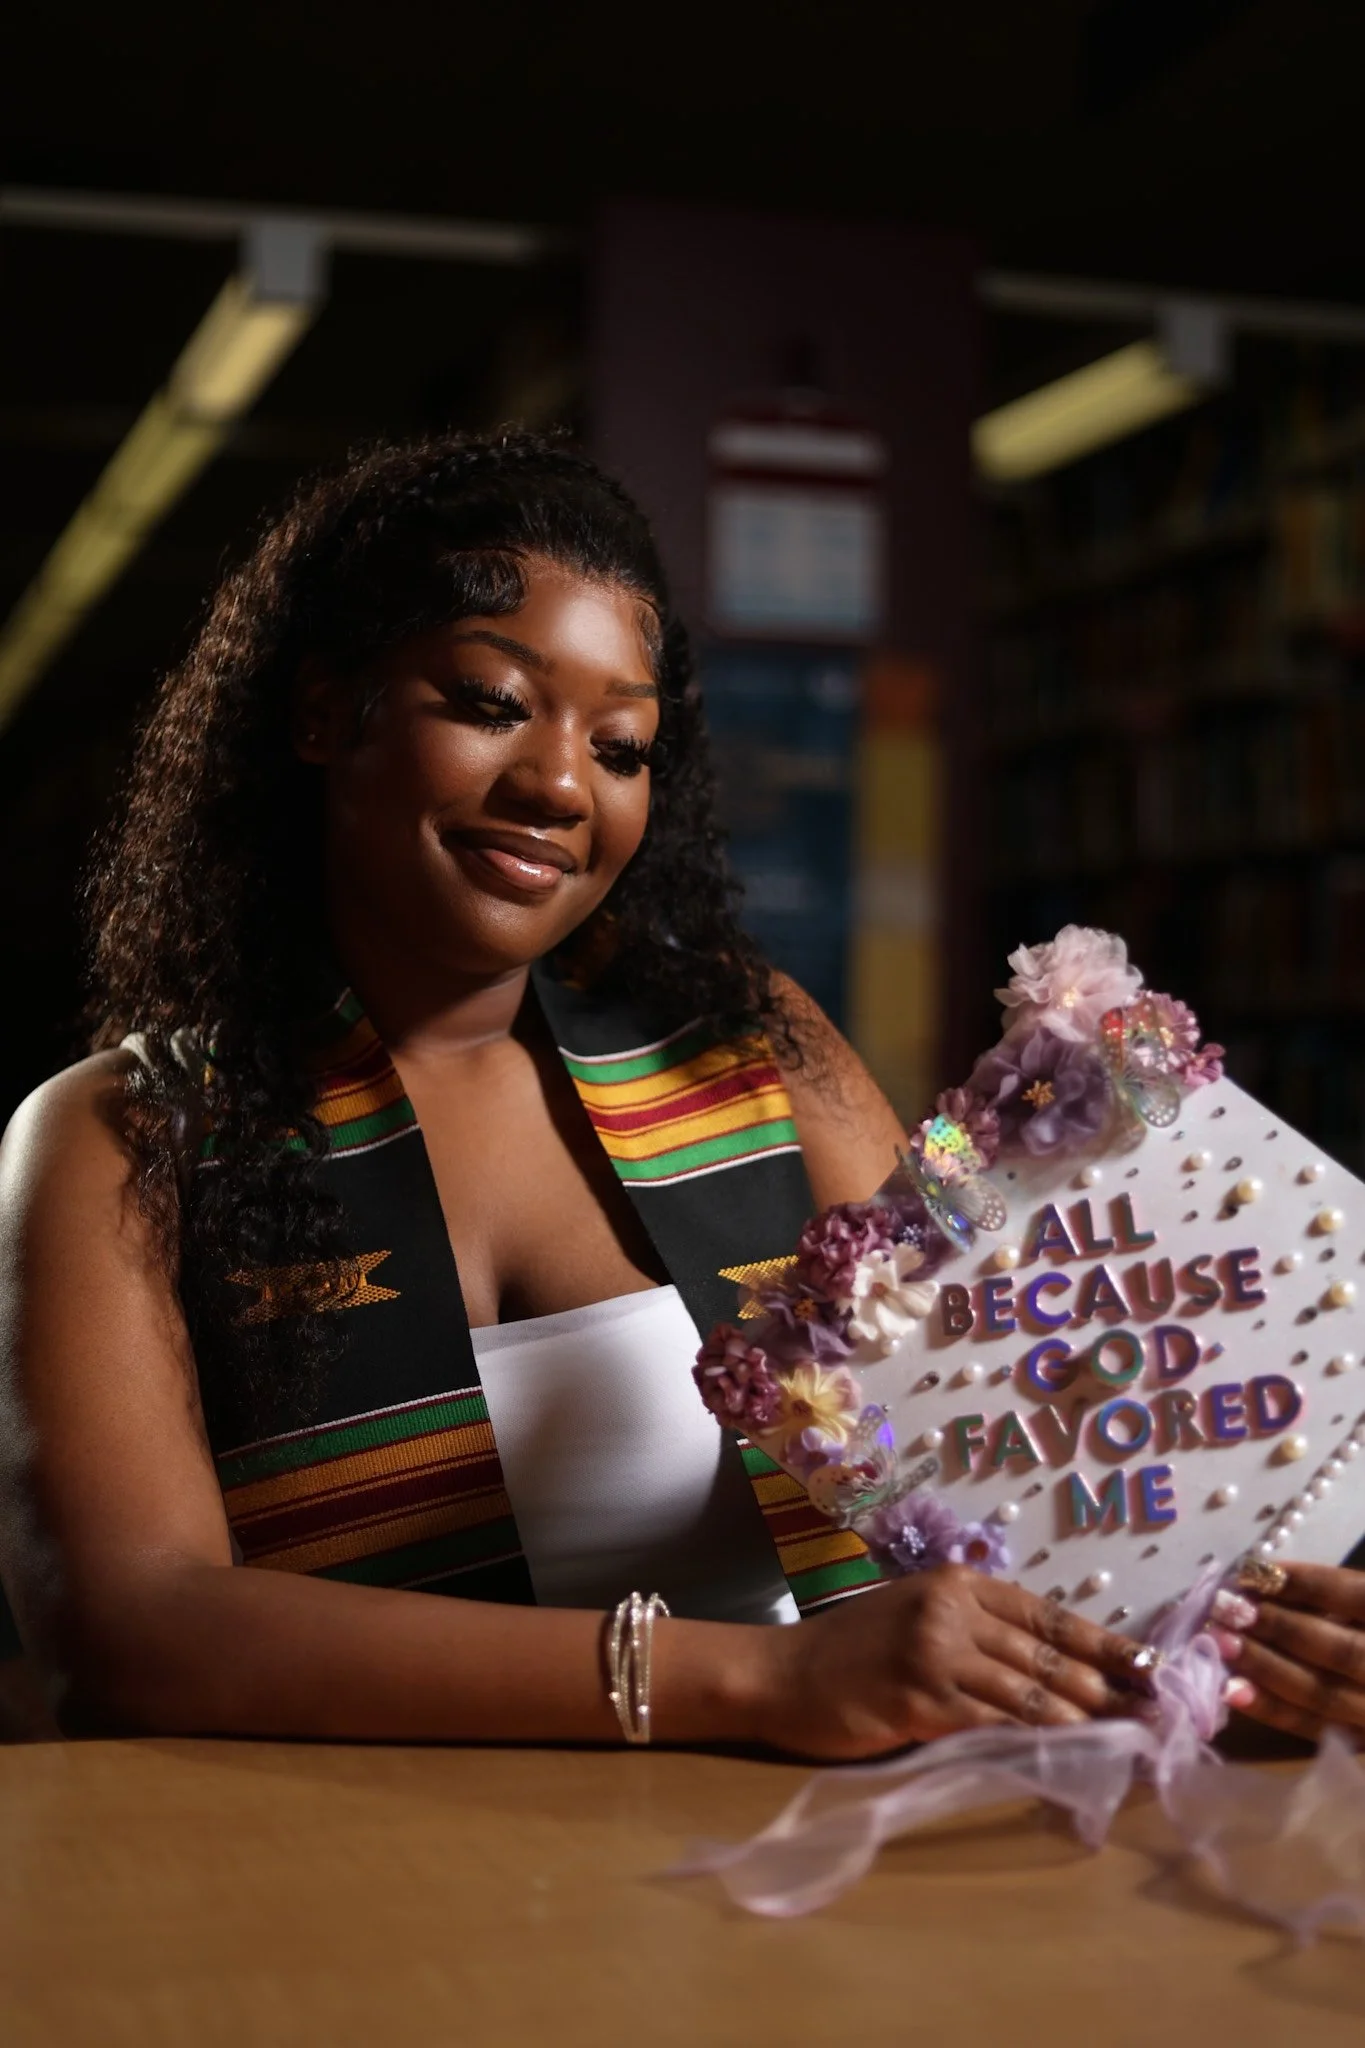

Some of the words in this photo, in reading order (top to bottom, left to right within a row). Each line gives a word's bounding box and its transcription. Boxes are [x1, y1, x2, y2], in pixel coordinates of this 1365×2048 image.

[1031, 1192, 1157, 1258] ALL
[940, 1247, 1267, 1336] BECAUSE
[1026, 1324, 1201, 1393] GOD
[955, 1374, 1303, 1468] FAVORED
[1071, 1464, 1178, 1528] ME
